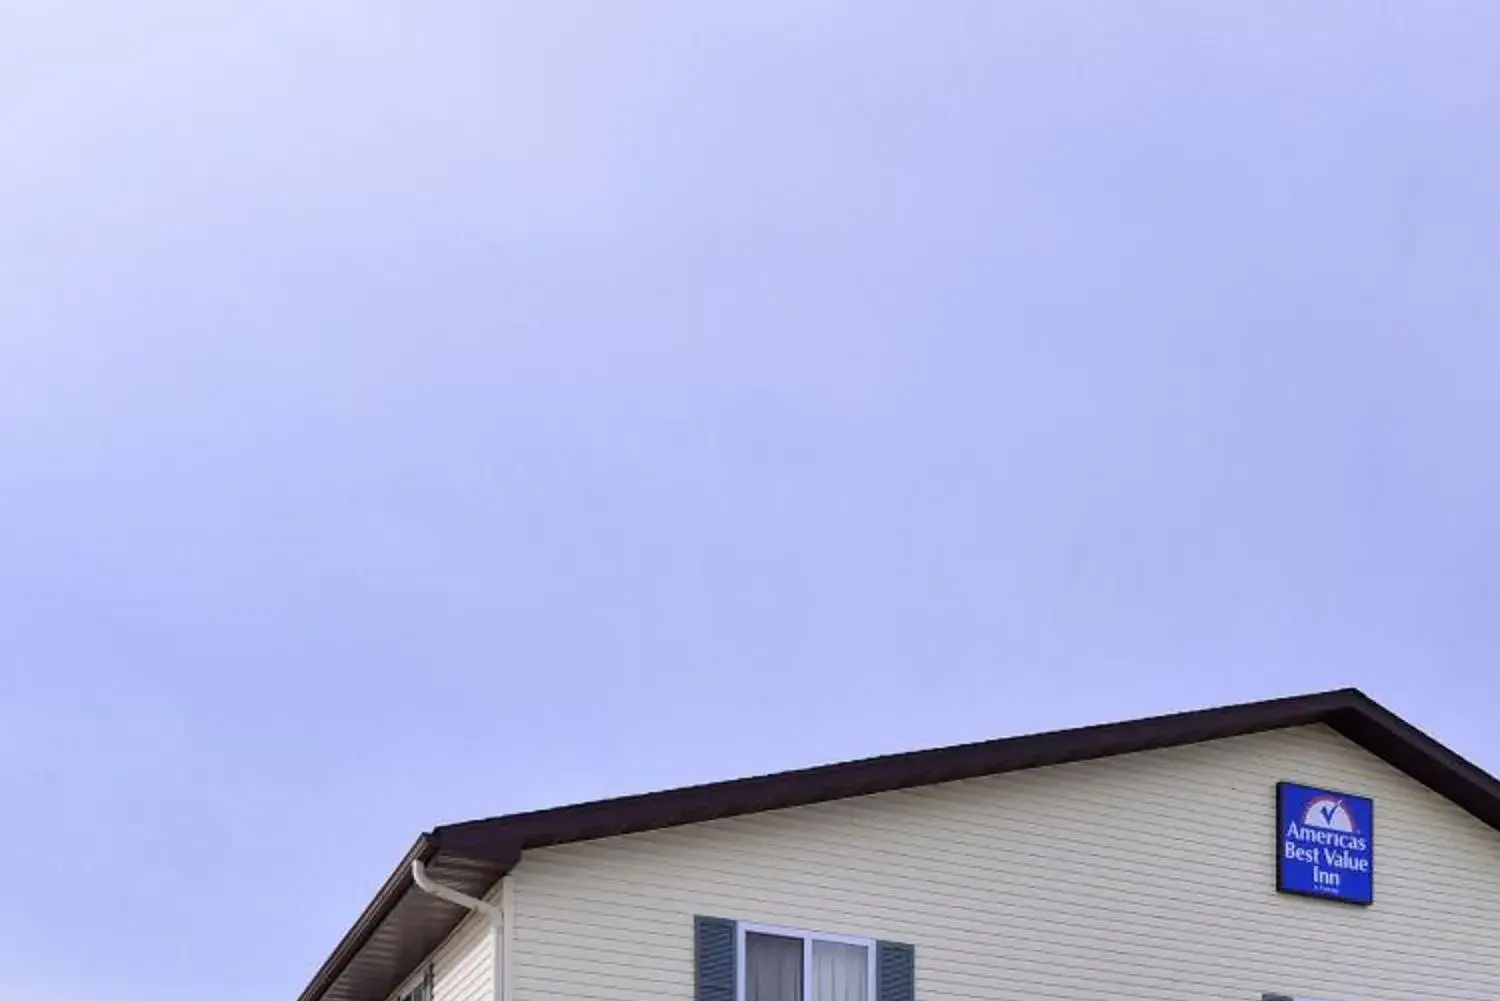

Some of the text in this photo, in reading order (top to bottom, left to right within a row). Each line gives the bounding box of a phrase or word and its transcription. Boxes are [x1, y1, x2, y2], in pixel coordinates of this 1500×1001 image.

[1286, 820, 1367, 851] Americas
[1285, 841, 1369, 872] Best Value
[1313, 865, 1340, 886] Inn
